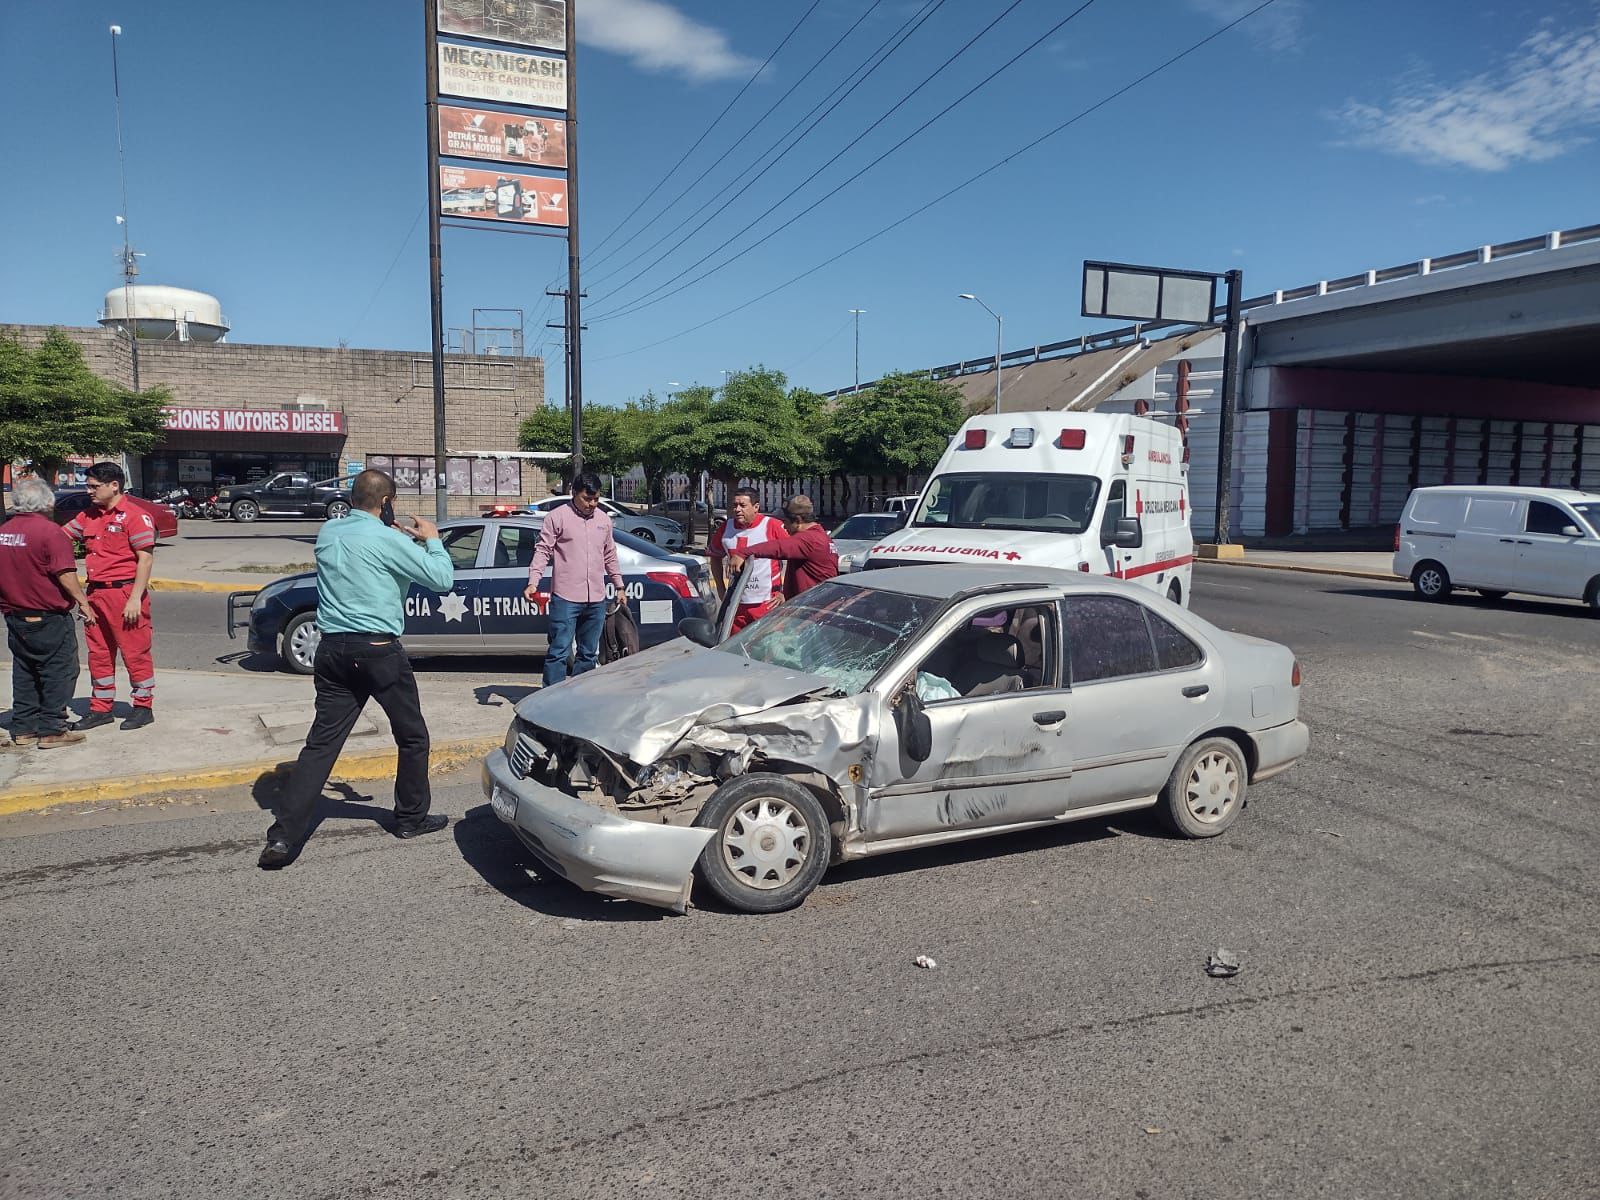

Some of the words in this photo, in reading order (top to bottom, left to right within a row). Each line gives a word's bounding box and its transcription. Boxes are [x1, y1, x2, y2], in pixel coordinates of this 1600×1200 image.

[444, 67, 495, 82] RESCATE
[498, 74, 564, 91] CARRETERO
[447, 130, 477, 142] DETRÁS
[447, 140, 471, 149] GRAN
[473, 142, 502, 154] MOTOR
[223, 411, 289, 431] MOTORES
[292, 412, 338, 432] DIESEL
[606, 582, 644, 600] 040
[473, 597, 490, 616] DE
